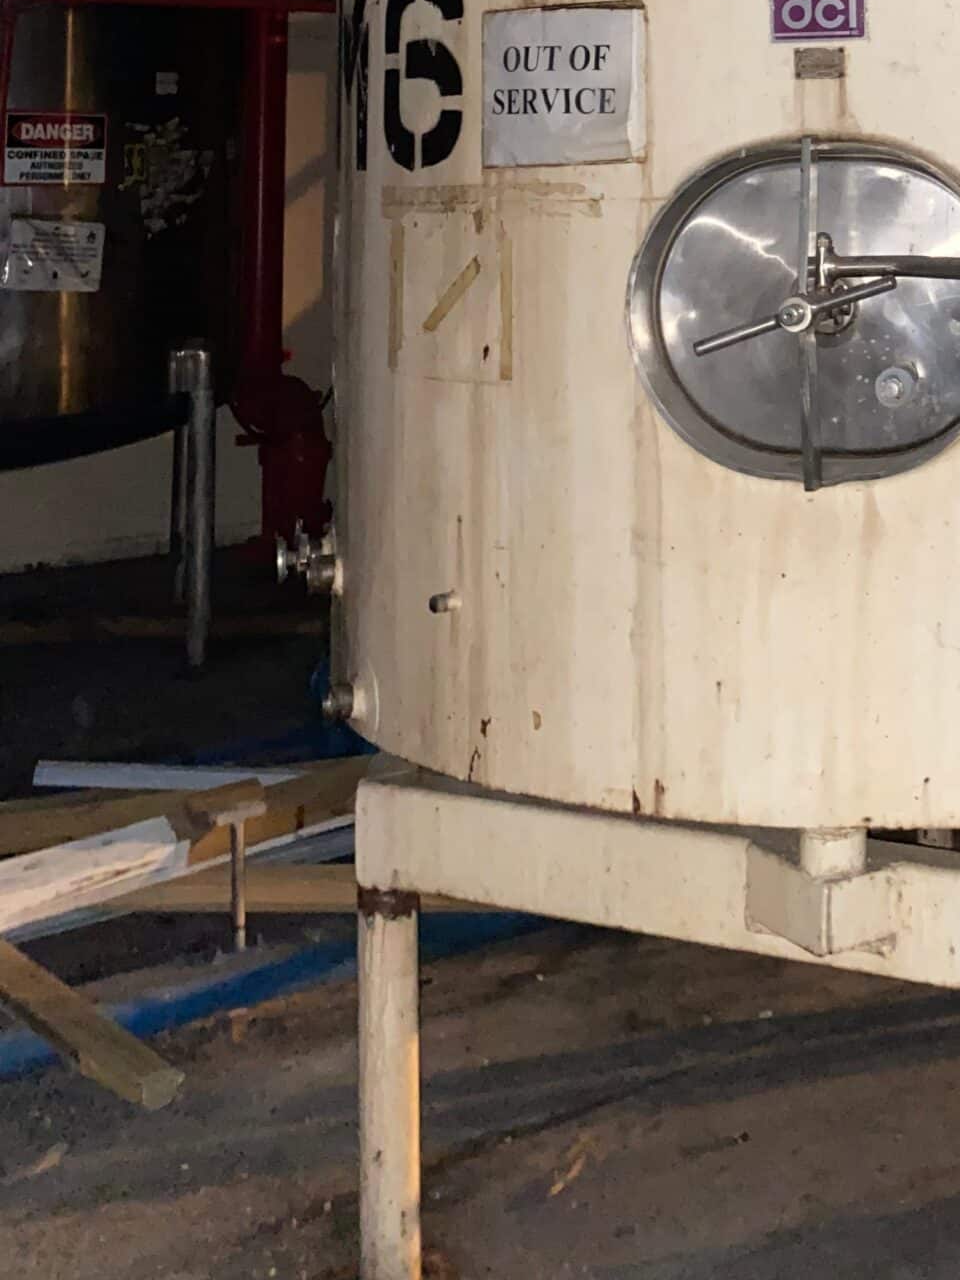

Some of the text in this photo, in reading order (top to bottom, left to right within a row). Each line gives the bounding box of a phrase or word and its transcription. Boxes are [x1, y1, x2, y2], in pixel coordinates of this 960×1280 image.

[502, 44, 611, 72] OUT OF
[491, 87, 617, 115] SERVICE
[20, 123, 94, 141] DANGER
[7, 150, 65, 159] CONFINED
